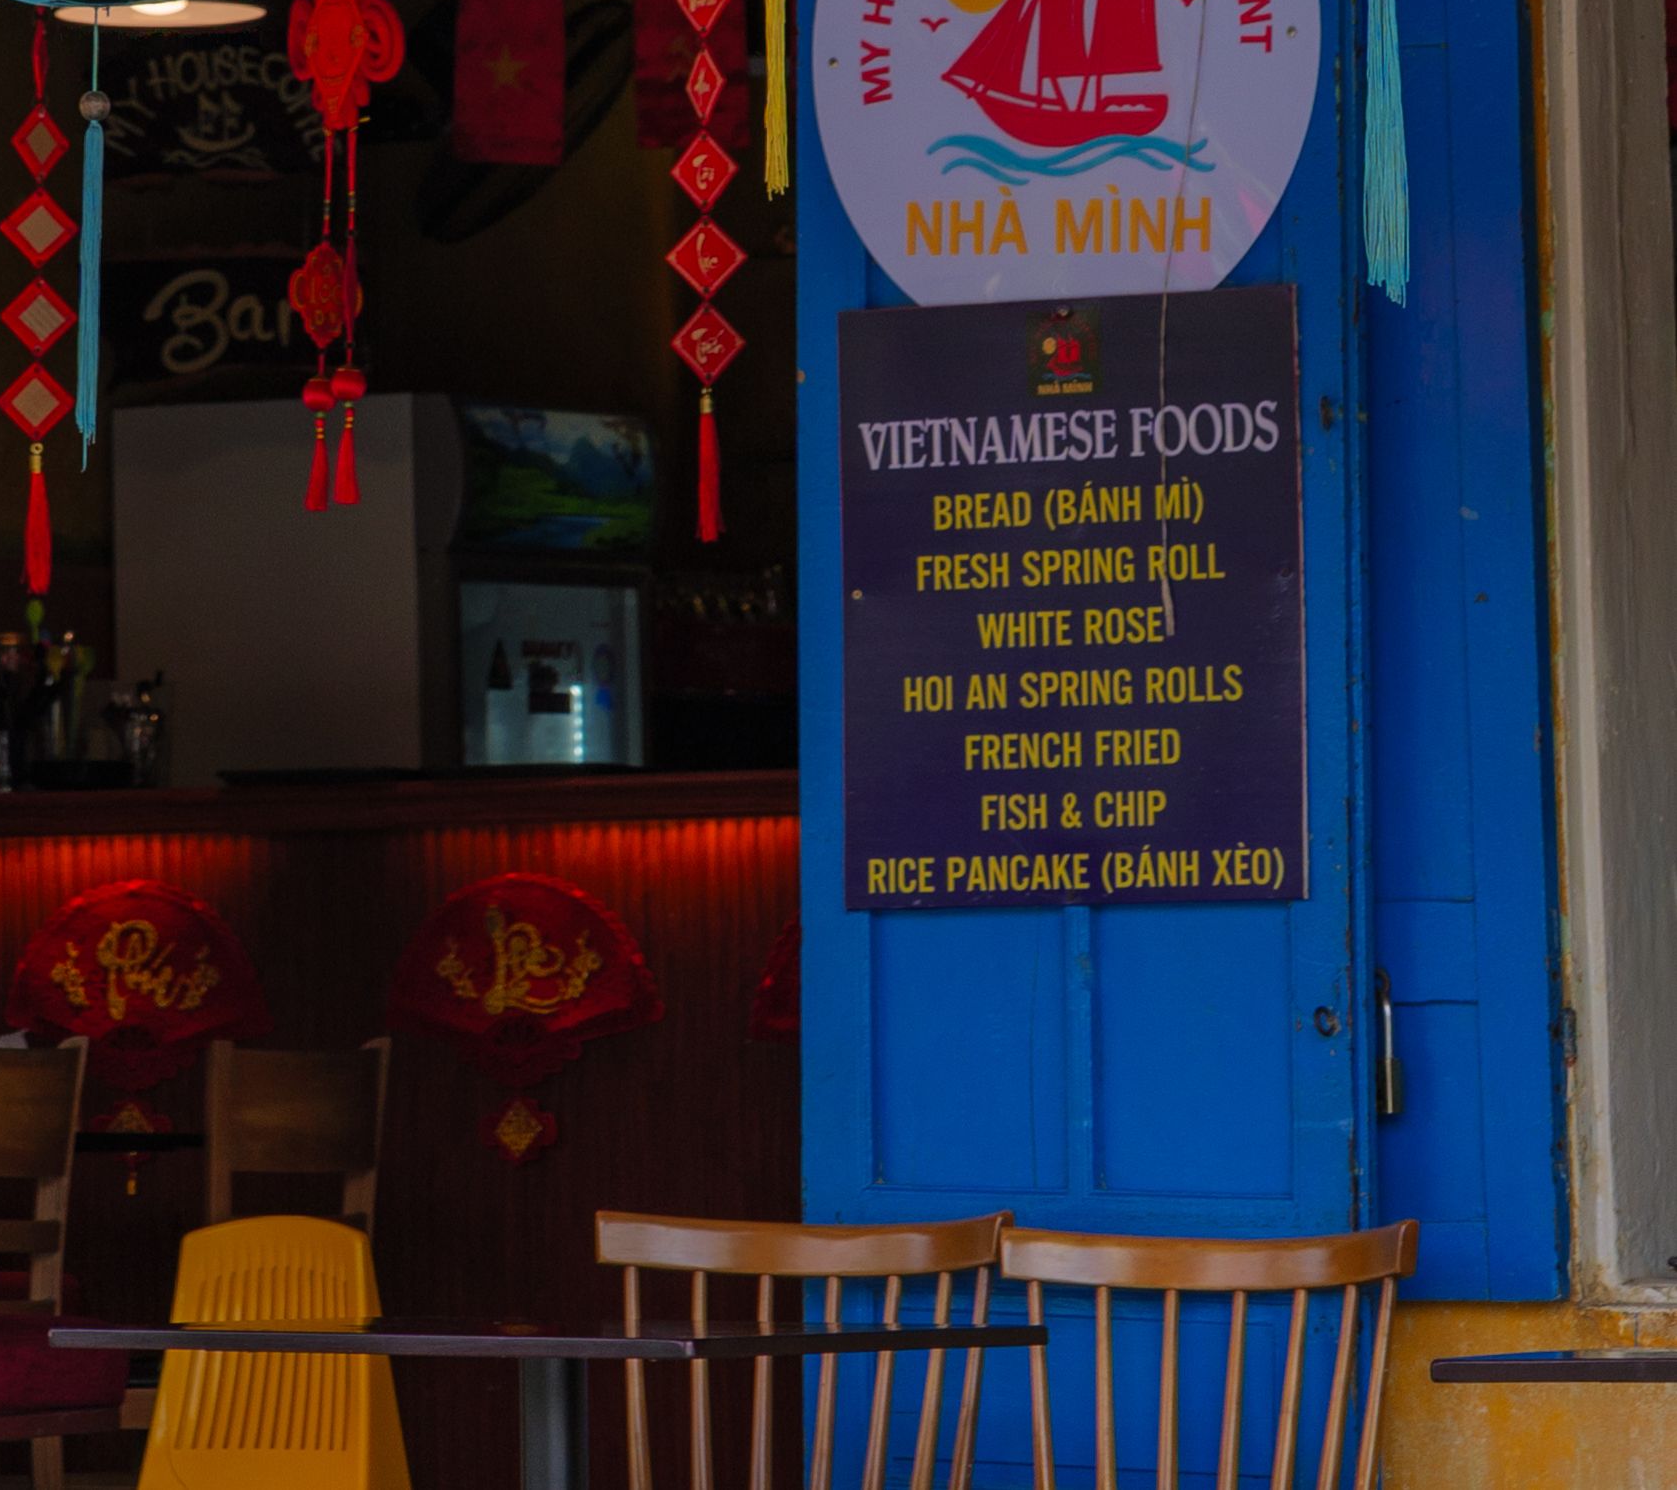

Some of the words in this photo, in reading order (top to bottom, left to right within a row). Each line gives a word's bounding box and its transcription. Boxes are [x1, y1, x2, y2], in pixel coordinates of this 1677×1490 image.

[860, 39, 893, 105] MY
[906, 185, 1028, 256] NHÀ
[1055, 184, 1212, 255] MÌNH
[858, 408, 1119, 471] VIETNAMESE
[1129, 400, 1280, 458] FOODS
[932, 490, 1032, 531] BREAD
[1043, 480, 1142, 530] (BÁNH
[1154, 475, 1204, 525] MÌ)
[916, 551, 1010, 592] FRESH
[1022, 546, 1135, 588] SPRING
[1147, 543, 1226, 582] ROLL
[976, 609, 1073, 649] WHITE
[1084, 606, 1165, 646] ROSE
[902, 675, 954, 713] HOI
[965, 673, 1008, 711] AN
[1019, 668, 1133, 709] SPRING
[1145, 664, 1244, 706] ROLLS
[964, 731, 1083, 771] FRENCH
[1094, 728, 1182, 768] FRIED
[980, 793, 1048, 831] FISH
[1060, 791, 1083, 829] &
[1094, 789, 1168, 828] CHIP
[867, 857, 936, 895] RICE
[946, 853, 1091, 894] PANCAKE
[1101, 845, 1200, 894] (BÁNH
[1211, 841, 1286, 891] XÈO)
